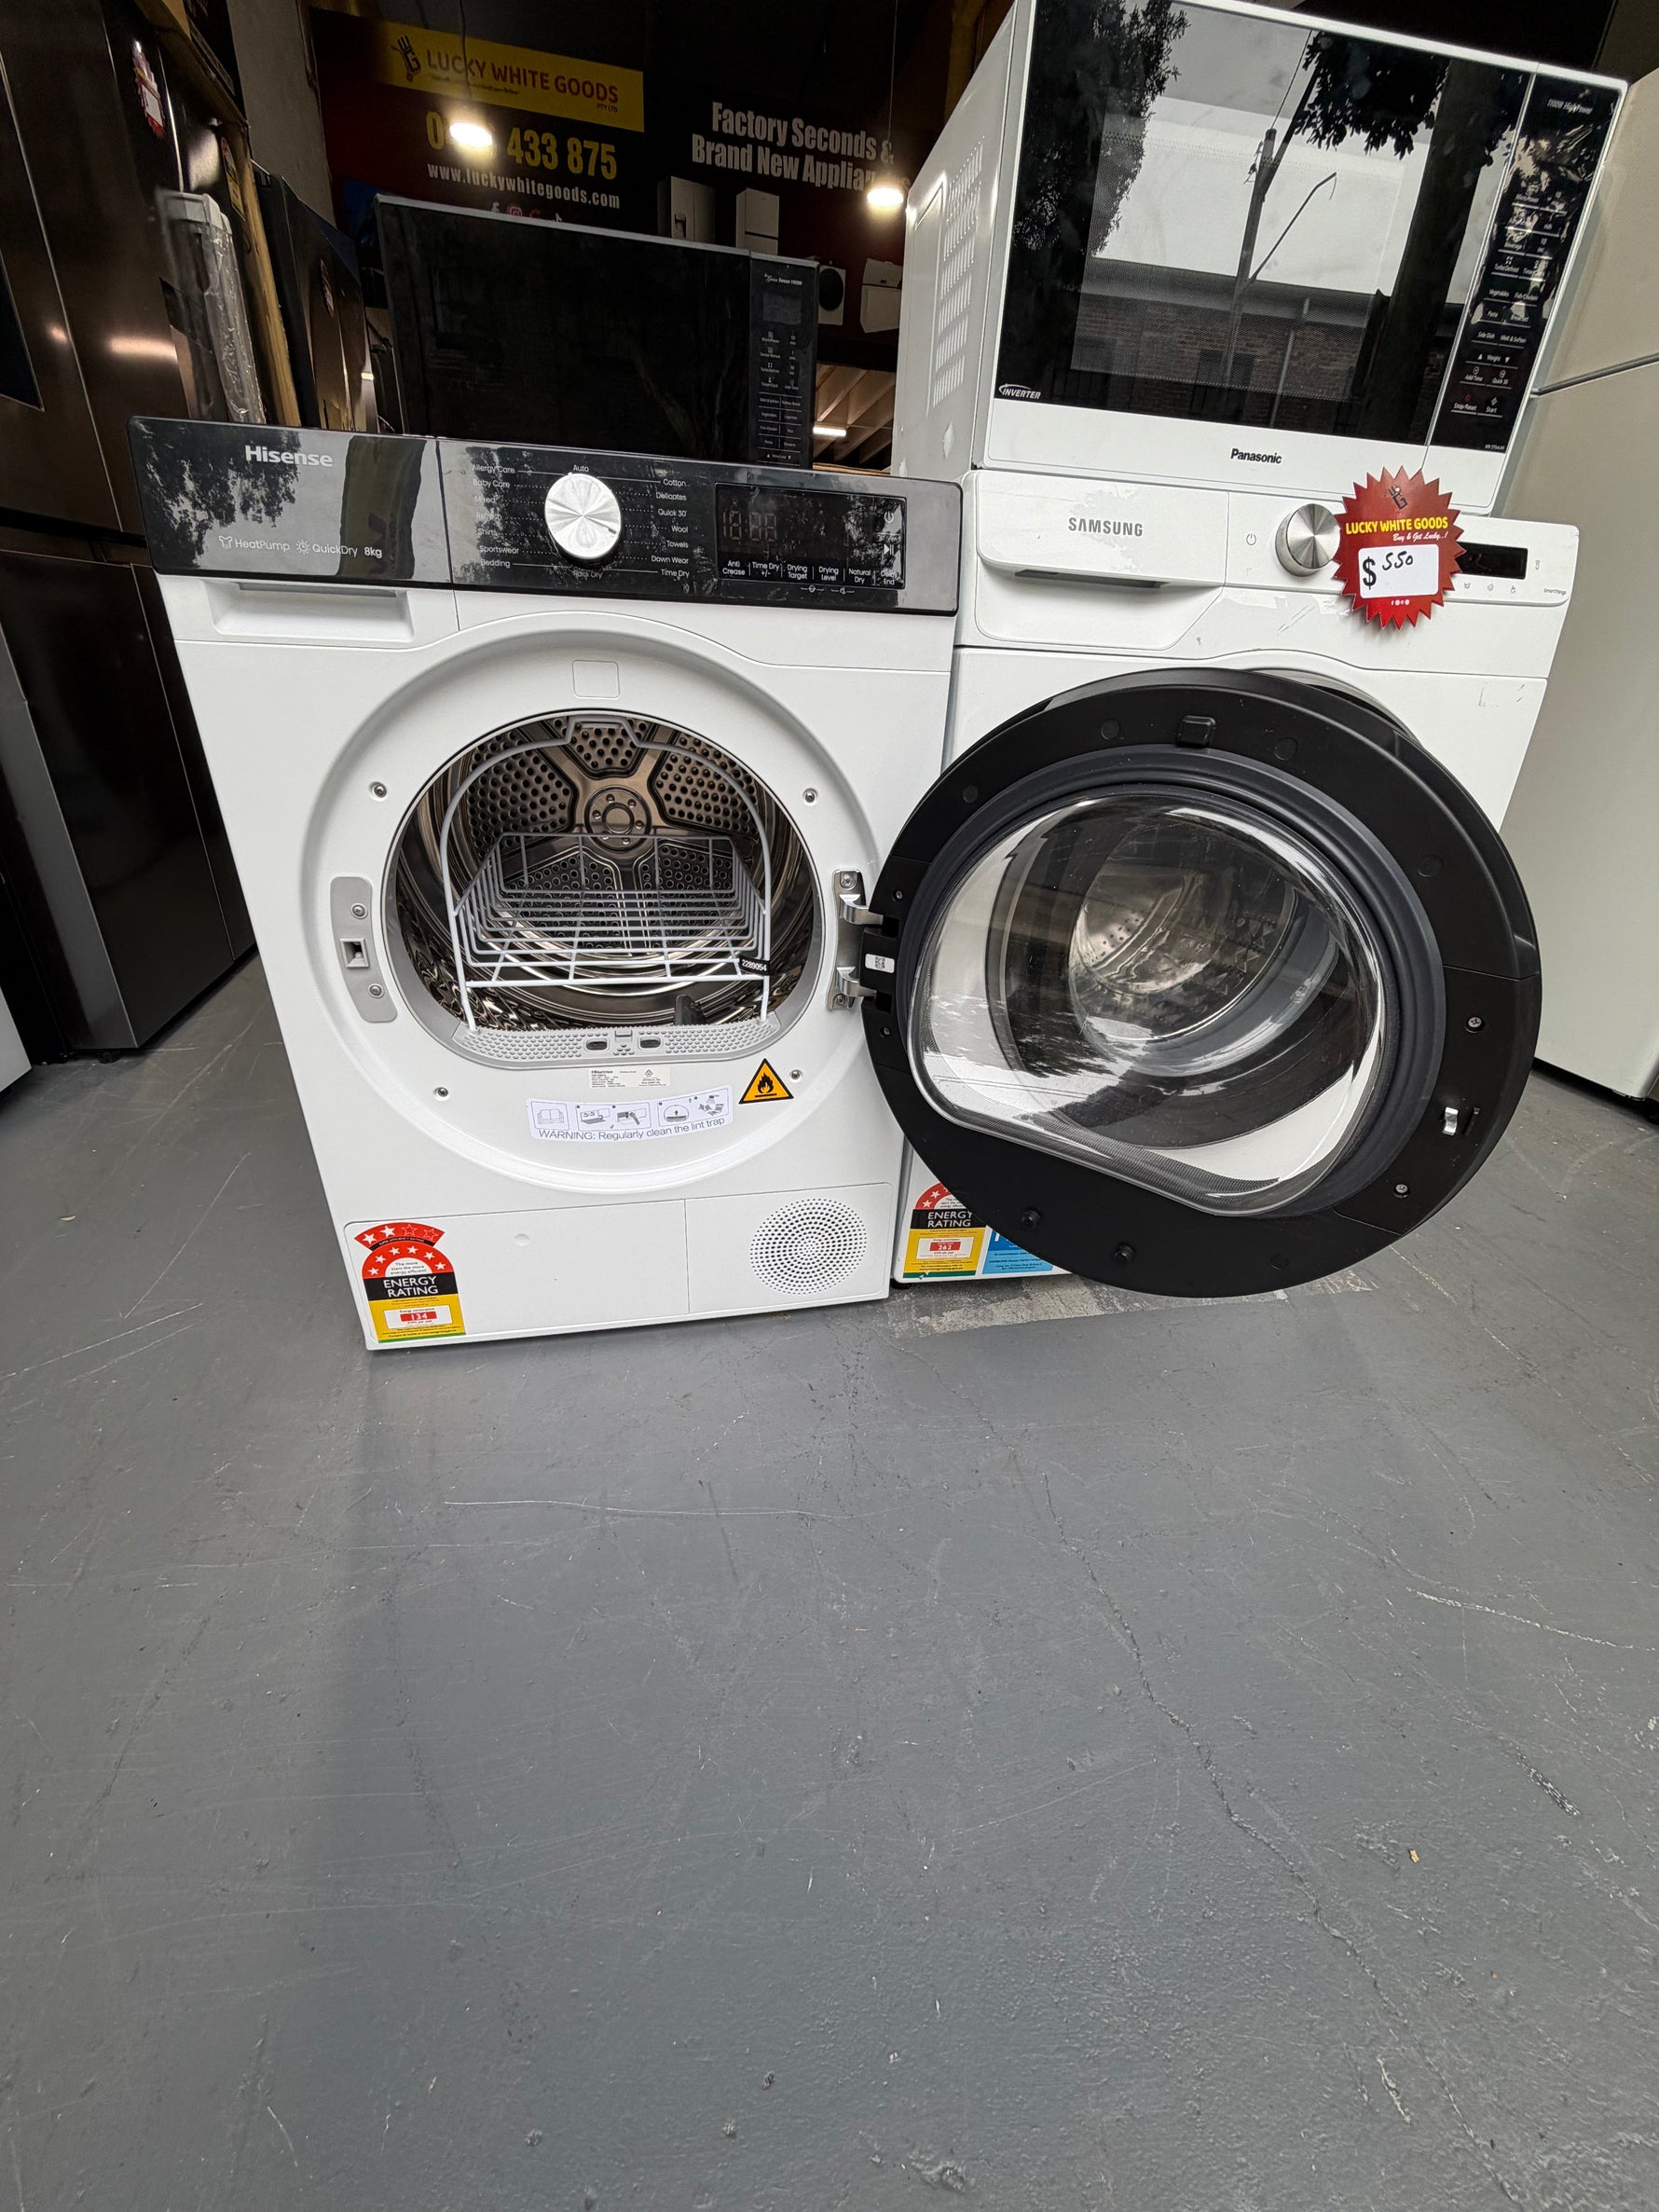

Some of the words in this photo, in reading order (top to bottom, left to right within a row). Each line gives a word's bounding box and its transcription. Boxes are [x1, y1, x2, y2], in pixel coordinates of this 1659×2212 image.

[426, 49, 487, 79] LUCKY
[490, 62, 550, 90] WHITE
[554, 76, 619, 104] GOODS
[712, 102, 788, 147] Factory
[792, 117, 877, 161] Seconds
[881, 140, 895, 165] &
[507, 127, 559, 171] 433
[566, 137, 618, 180] 875
[692, 133, 753, 173] Brand
[757, 145, 800, 181] New
[427, 163, 621, 210] www.luckywhitegoods.com
[1001, 386, 1042, 401] INVERTER
[244, 445, 334, 467] Hisense
[1230, 447, 1282, 464] Panasonic
[472, 464, 496, 474] Allergy
[497, 465, 515, 474] Care
[572, 464, 590, 473] Auto
[473, 478, 491, 488] Baby
[492, 480, 511, 488] Care
[663, 478, 687, 488] Cotton
[655, 491, 687, 501] Delicates
[657, 508, 678, 516] Quick
[671, 525, 689, 533] Wool
[1068, 516, 1144, 537] SAMSUNG
[1345, 520, 1378, 535] LUCKY
[1379, 518, 1412, 532] WHITE
[1414, 516, 1448, 530] GOODS
[1392, 532, 1405, 543] Buy
[1405, 532, 1411, 541] &
[1412, 531, 1422, 543] Get
[235, 537, 291, 553] HeatPump
[666, 540, 689, 548] Towels
[312, 542, 359, 557] QuickDry
[363, 546, 382, 559] 8kg
[479, 544, 519, 555] Sportswear
[481, 558, 511, 569] Bedding
[651, 555, 671, 563] Down
[727, 559, 741, 568] Anti
[751, 561, 768, 570] Time
[768, 562, 780, 571] Dry
[787, 564, 808, 573] Drying
[818, 566, 839, 575] Drying
[661, 568, 678, 576] Time
[678, 570, 690, 578] Dry
[722, 568, 746, 576] Crease
[787, 571, 808, 580] Target
[848, 568, 871, 576] Natural
[820, 573, 837, 582] Level
[854, 576, 866, 584] Dry
[538, 1129, 597, 1141] WARNING:
[598, 1128, 645, 1141] Regularly
[647, 1125, 672, 1137] clean
[674, 1122, 691, 1133] the
[691, 1119, 705, 1131] lint
[706, 1118, 726, 1131] trap
[927, 1210, 973, 1220] ENERGY
[927, 1219, 971, 1229] RATING
[383, 1275, 437, 1289] ENERGY
[388, 1285, 439, 1298] RATING
